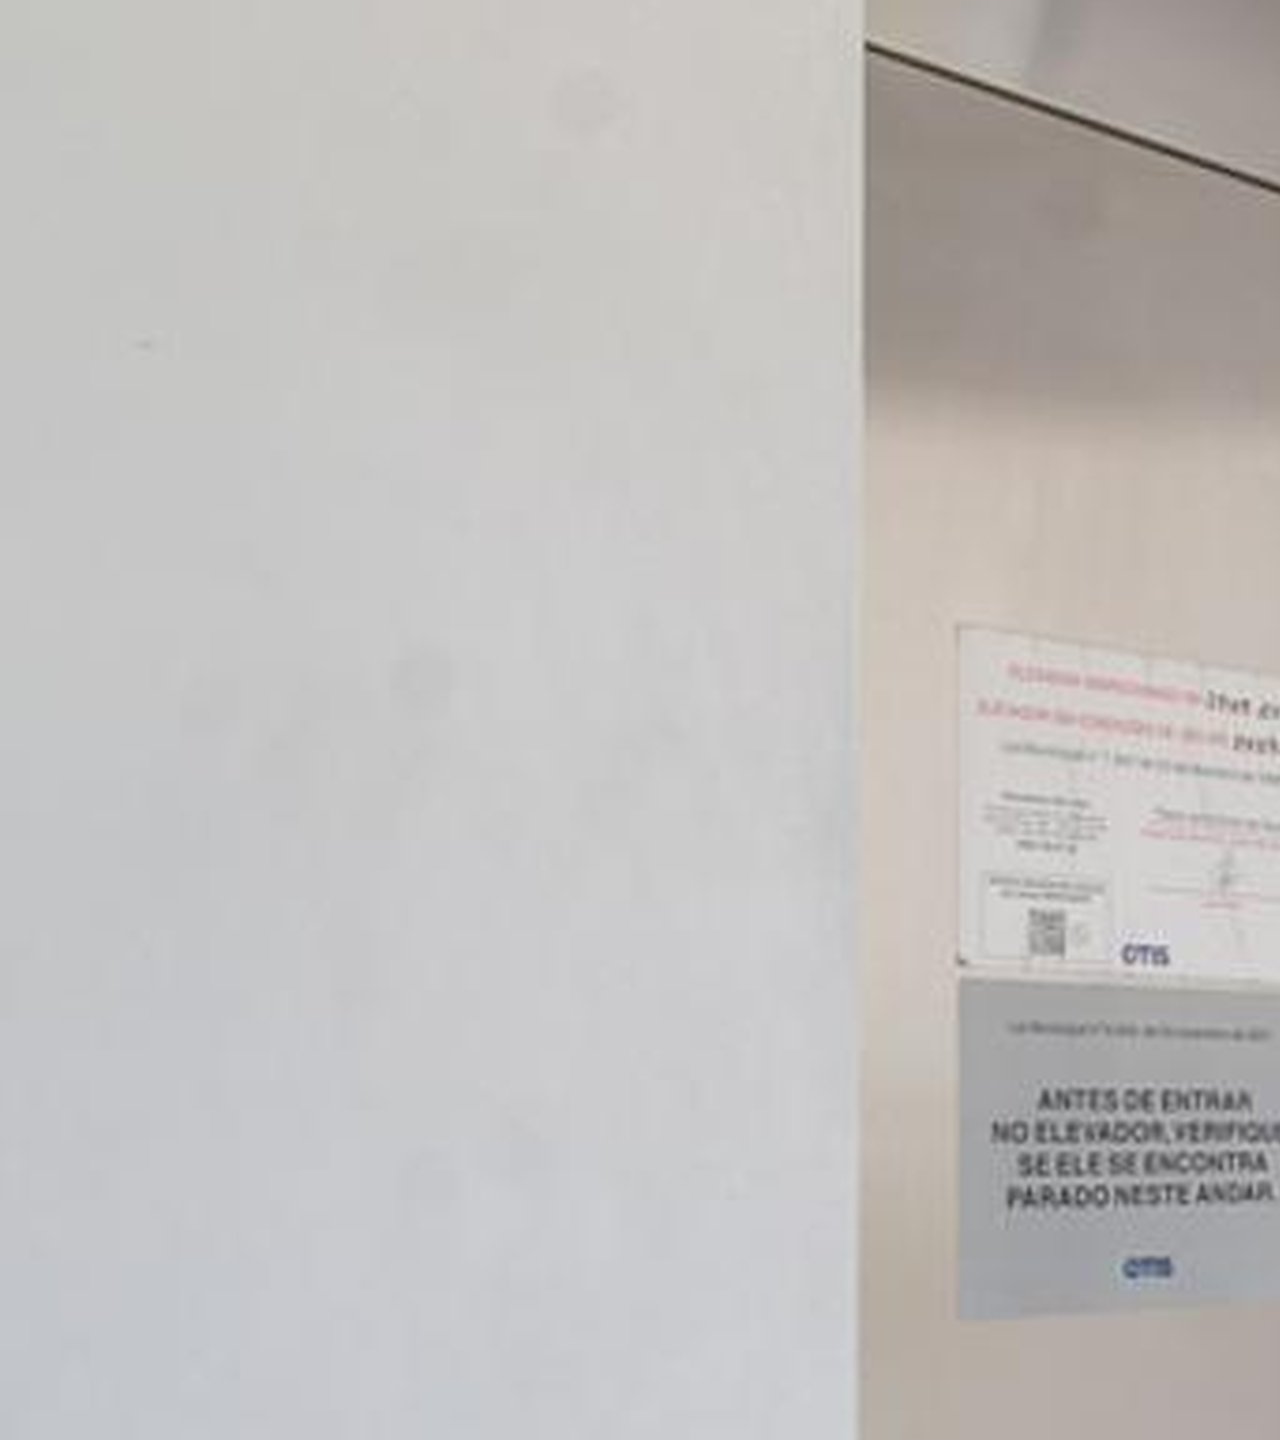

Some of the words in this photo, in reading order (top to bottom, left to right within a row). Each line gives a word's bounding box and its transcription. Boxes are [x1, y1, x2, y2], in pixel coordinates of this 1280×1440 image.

[1121, 944, 1171, 966] OTIS
[1037, 1088, 1120, 1112] ANTES
[1123, 1088, 1155, 1112] DE
[1160, 1088, 1253, 1112] ENTRAR
[991, 1120, 1029, 1144] NO
[1016, 1152, 1047, 1177] SE
[1056, 1152, 1101, 1177] ELE
[1108, 1151, 1138, 1176] SE
[1143, 1150, 1270, 1175] ENCONTRA
[1006, 1184, 1111, 1210] PARADO
[1114, 1184, 1190, 1207] NESTE
